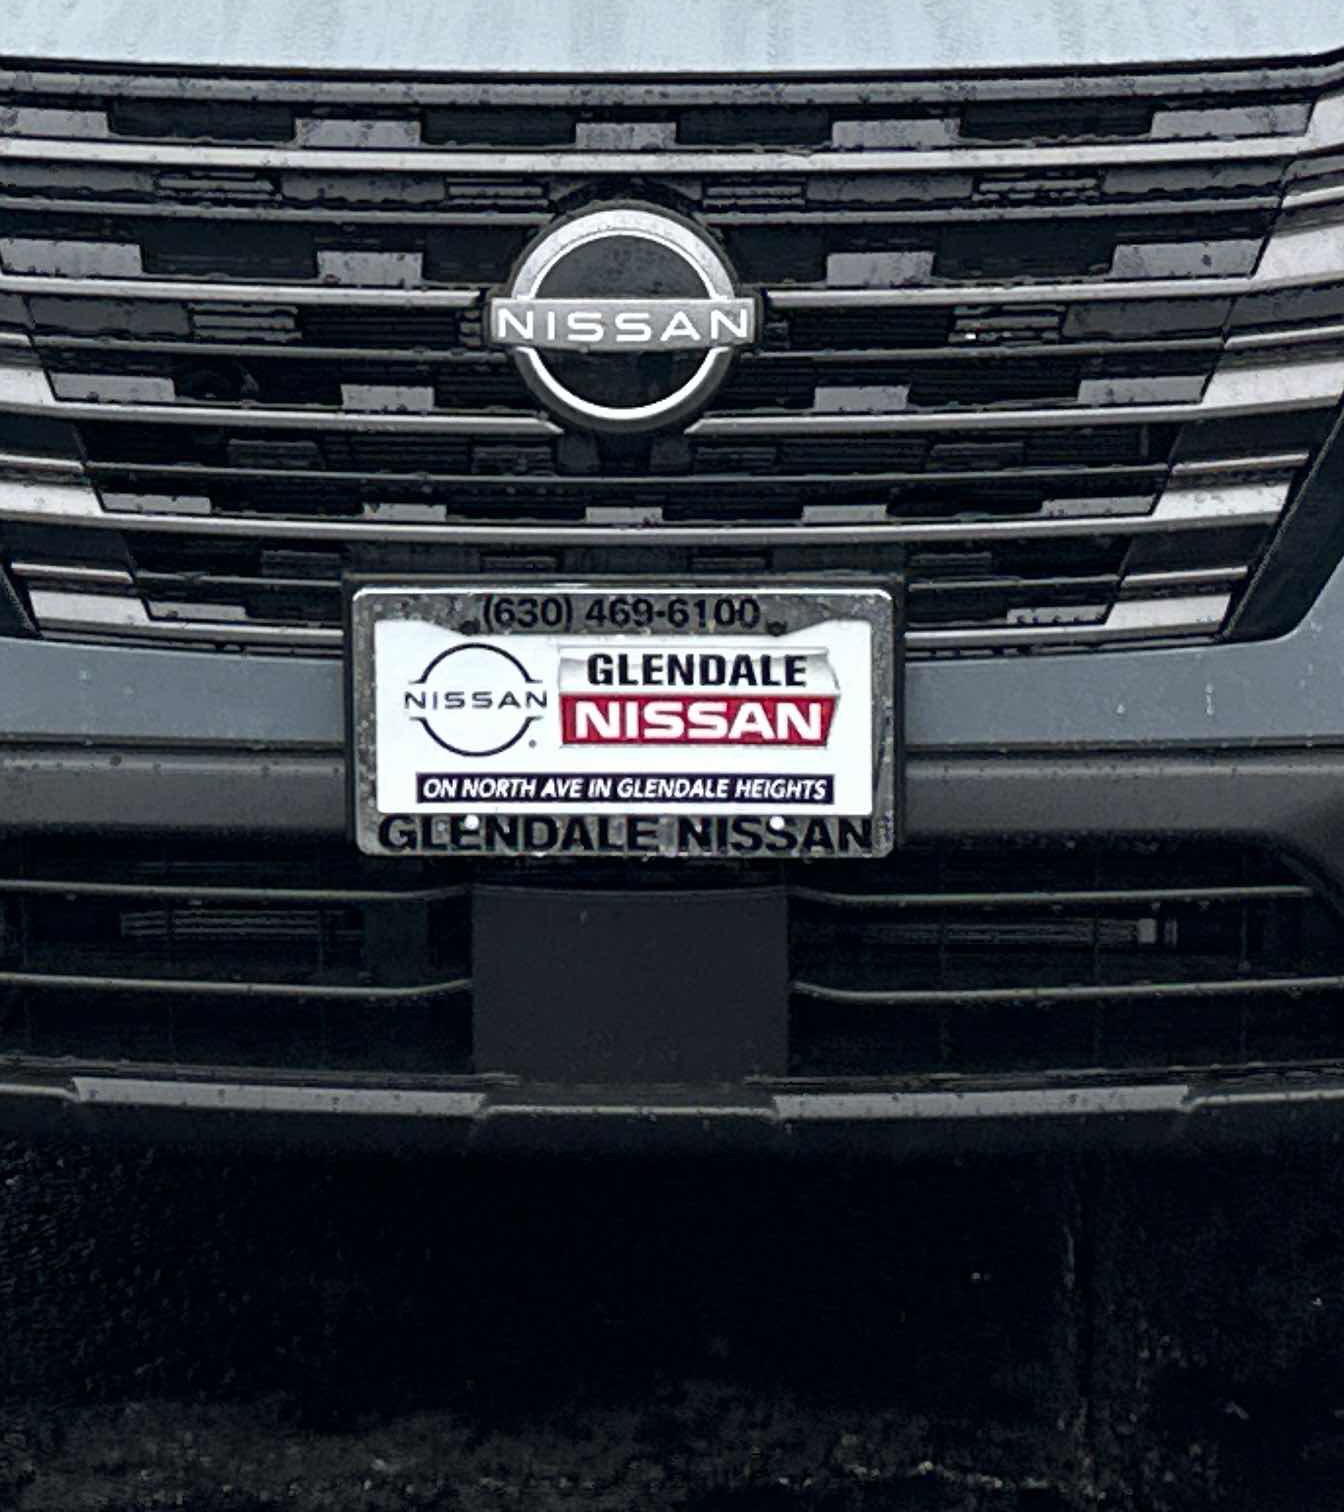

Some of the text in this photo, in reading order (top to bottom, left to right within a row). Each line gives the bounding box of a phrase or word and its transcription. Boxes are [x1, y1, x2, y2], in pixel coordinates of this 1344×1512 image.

[497, 308, 748, 341] NISSAN
[484, 594, 761, 632] (630) 469-6100
[587, 653, 807, 686] GLENDALE
[404, 690, 547, 710] NISSAN
[575, 701, 822, 740] NISSAN
[423, 777, 827, 800] ON NORTH AVE IN GLENDALE HEIGHTS
[378, 814, 873, 851] GLENDALE NISSAN
